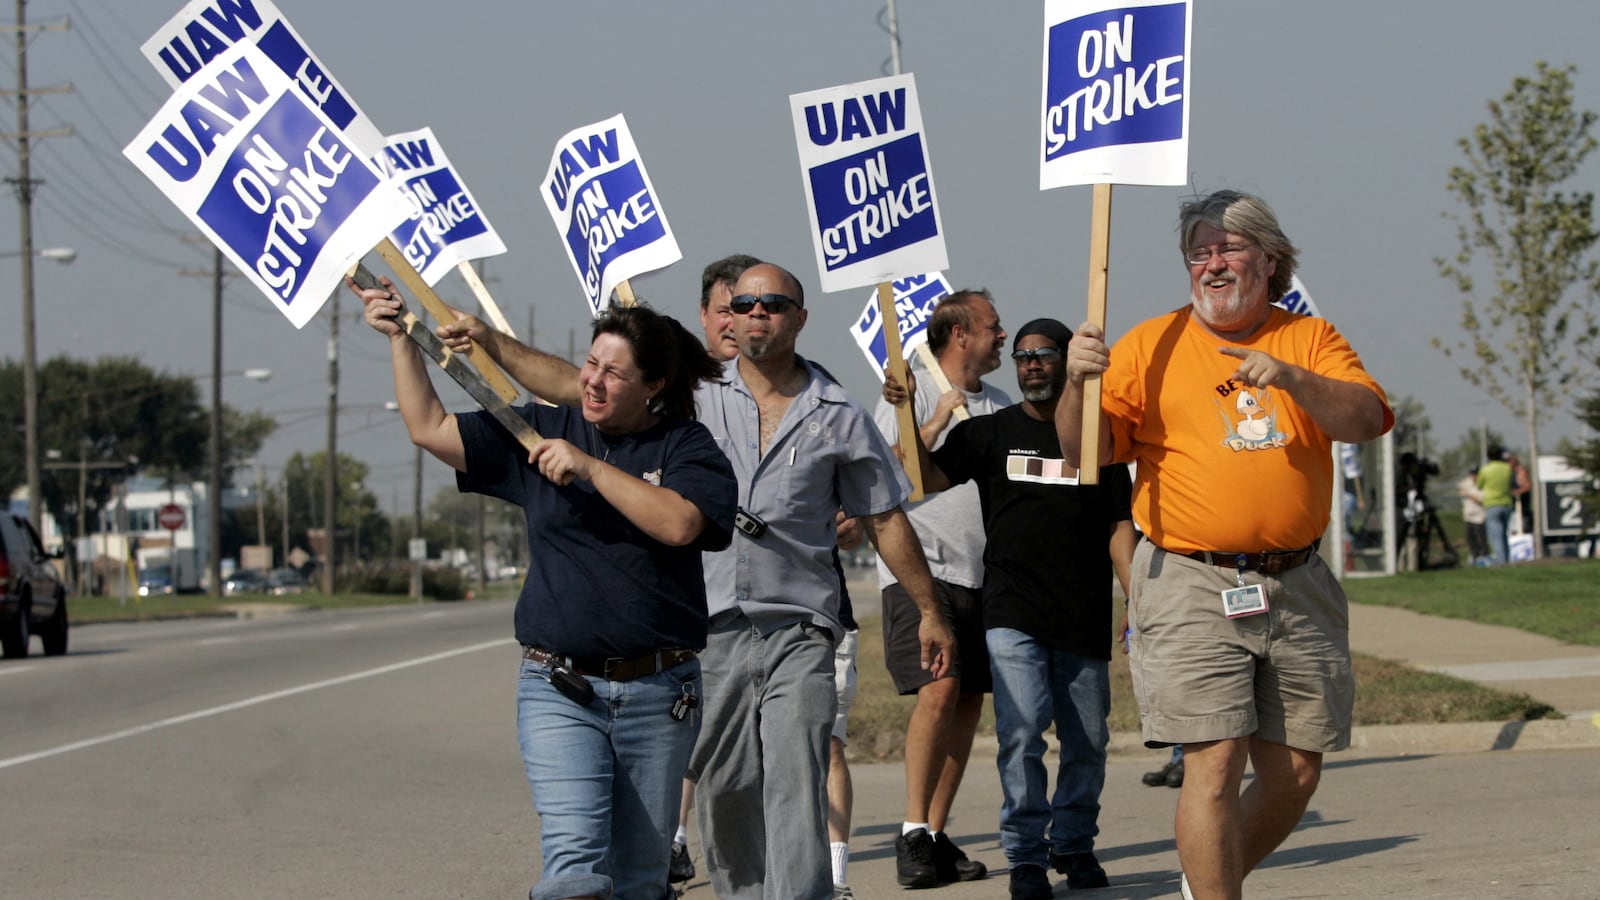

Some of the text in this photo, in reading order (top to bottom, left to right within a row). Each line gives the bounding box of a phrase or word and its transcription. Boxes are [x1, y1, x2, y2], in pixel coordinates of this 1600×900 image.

[158, 0, 263, 83] UAW
[1077, 14, 1134, 78] ON
[146, 56, 270, 182] UAW
[804, 87, 906, 146] UAW
[1047, 55, 1184, 156] STRIKE
[233, 134, 289, 215] ON
[550, 128, 620, 212] UAW
[575, 180, 609, 240] ON
[844, 150, 889, 206] ON
[256, 126, 352, 299] STRIKE
[403, 191, 476, 273] STRIKE
[585, 188, 657, 308] STRIKE
[822, 172, 932, 267] STRIKE
[1215, 379, 1239, 398] BE
[1559, 497, 1583, 527] 2
